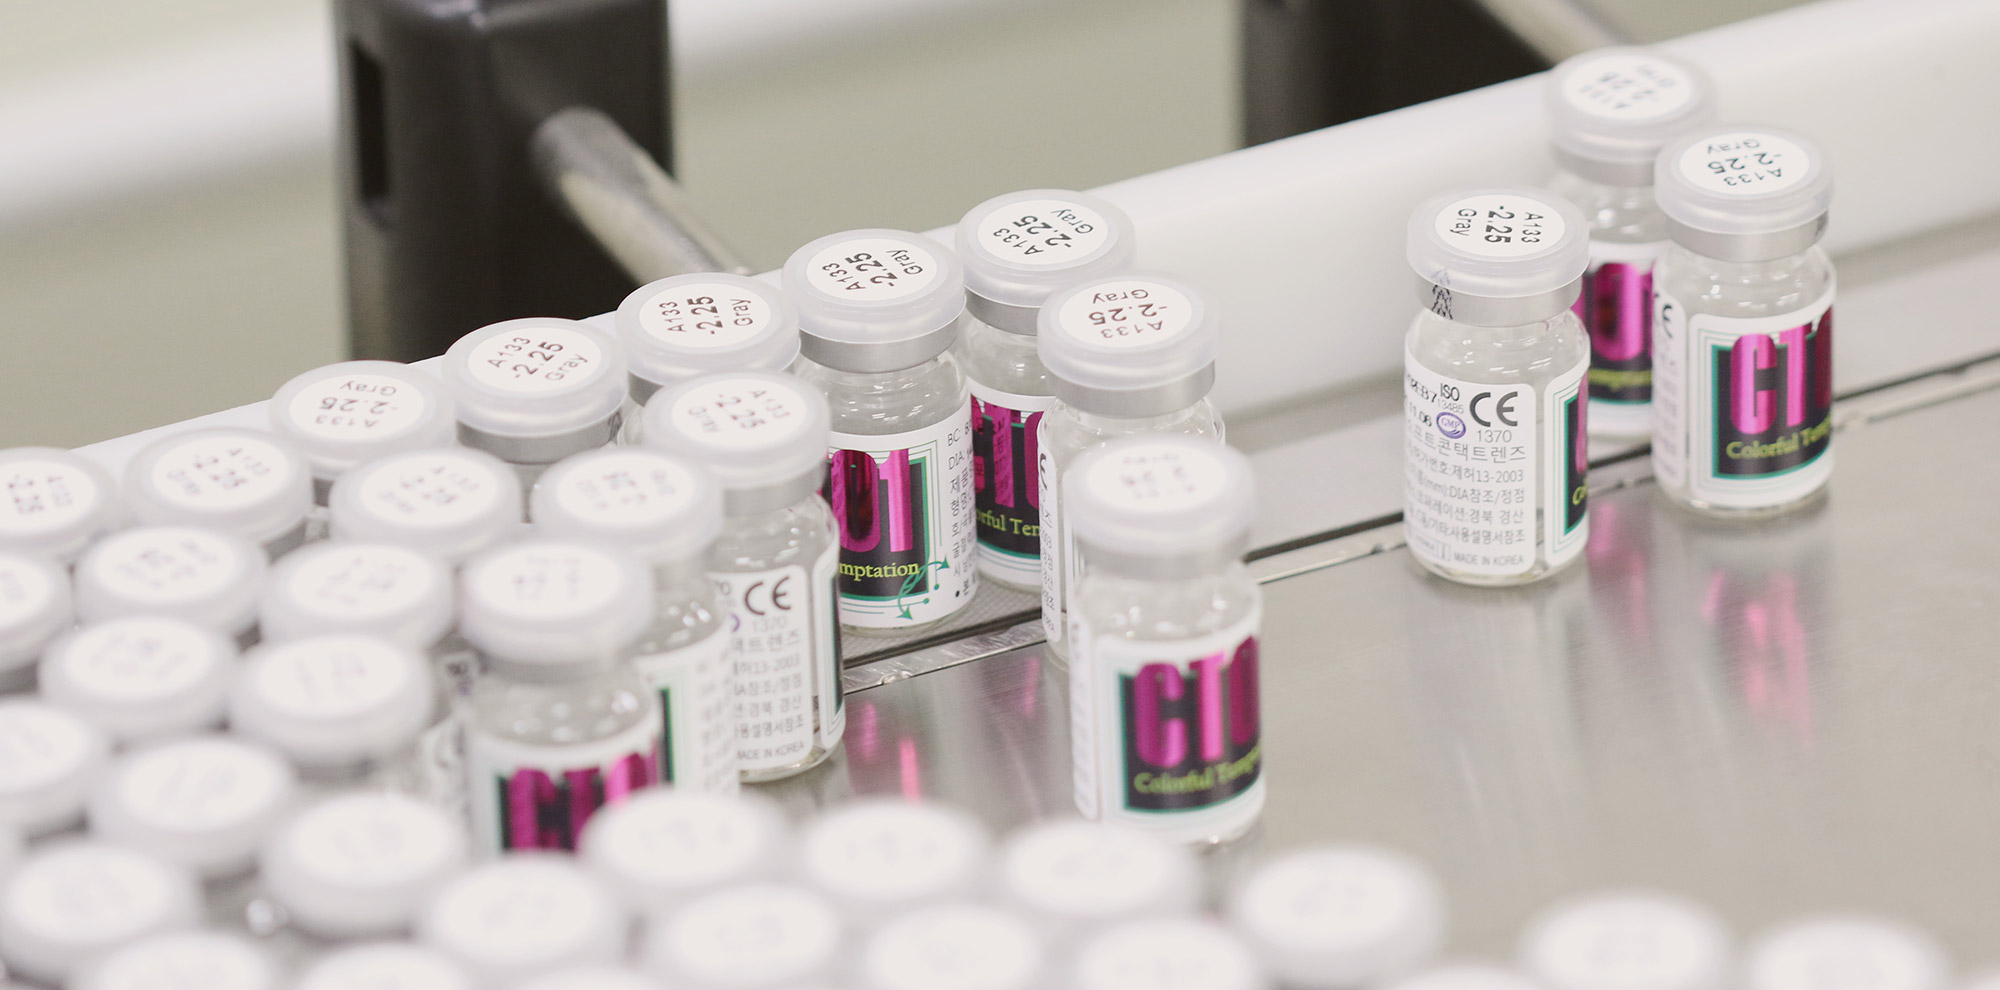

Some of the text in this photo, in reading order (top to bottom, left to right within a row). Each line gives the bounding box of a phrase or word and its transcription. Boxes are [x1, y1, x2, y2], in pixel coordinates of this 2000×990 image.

[1707, 139, 1761, 154] Gray
[1707, 153, 1782, 174] -2.25
[1723, 168, 1782, 186] A133
[1012, 215, 1073, 248] -2.25
[1050, 208, 1094, 234] Gray
[1450, 208, 1477, 236] Gray
[1484, 205, 1515, 243] -2.25
[1520, 211, 1544, 243] A133
[993, 228, 1044, 255] A133
[845, 252, 898, 287] -2.25
[886, 249, 923, 275] Gray
[822, 262, 867, 290] A133
[1092, 288, 1149, 304] Gray
[659, 301, 687, 332] A133
[687, 296, 723, 335] -2.25
[729, 298, 753, 326] Gray
[1088, 303, 1168, 326] -2.25
[1100, 320, 1163, 339] A133
[487, 337, 531, 368] A133
[512, 341, 564, 379] -2.25
[544, 354, 588, 381] Gray
[340, 380, 397, 396] Gray
[1440, 382, 1460, 402] ISO
[1437, 399, 1464, 415] 13485
[1469, 391, 1518, 428] CE
[1440, 416, 1461, 433] GMP
[1477, 429, 1512, 443] 1370
[1726, 433, 1800, 460] Colorful
[839, 561, 919, 582] mptation
[1454, 552, 1524, 566] MADE IN KOREA
[745, 576, 791, 615] CE
[752, 616, 788, 633] 1370
[737, 741, 805, 760] MADE IN KOREA
